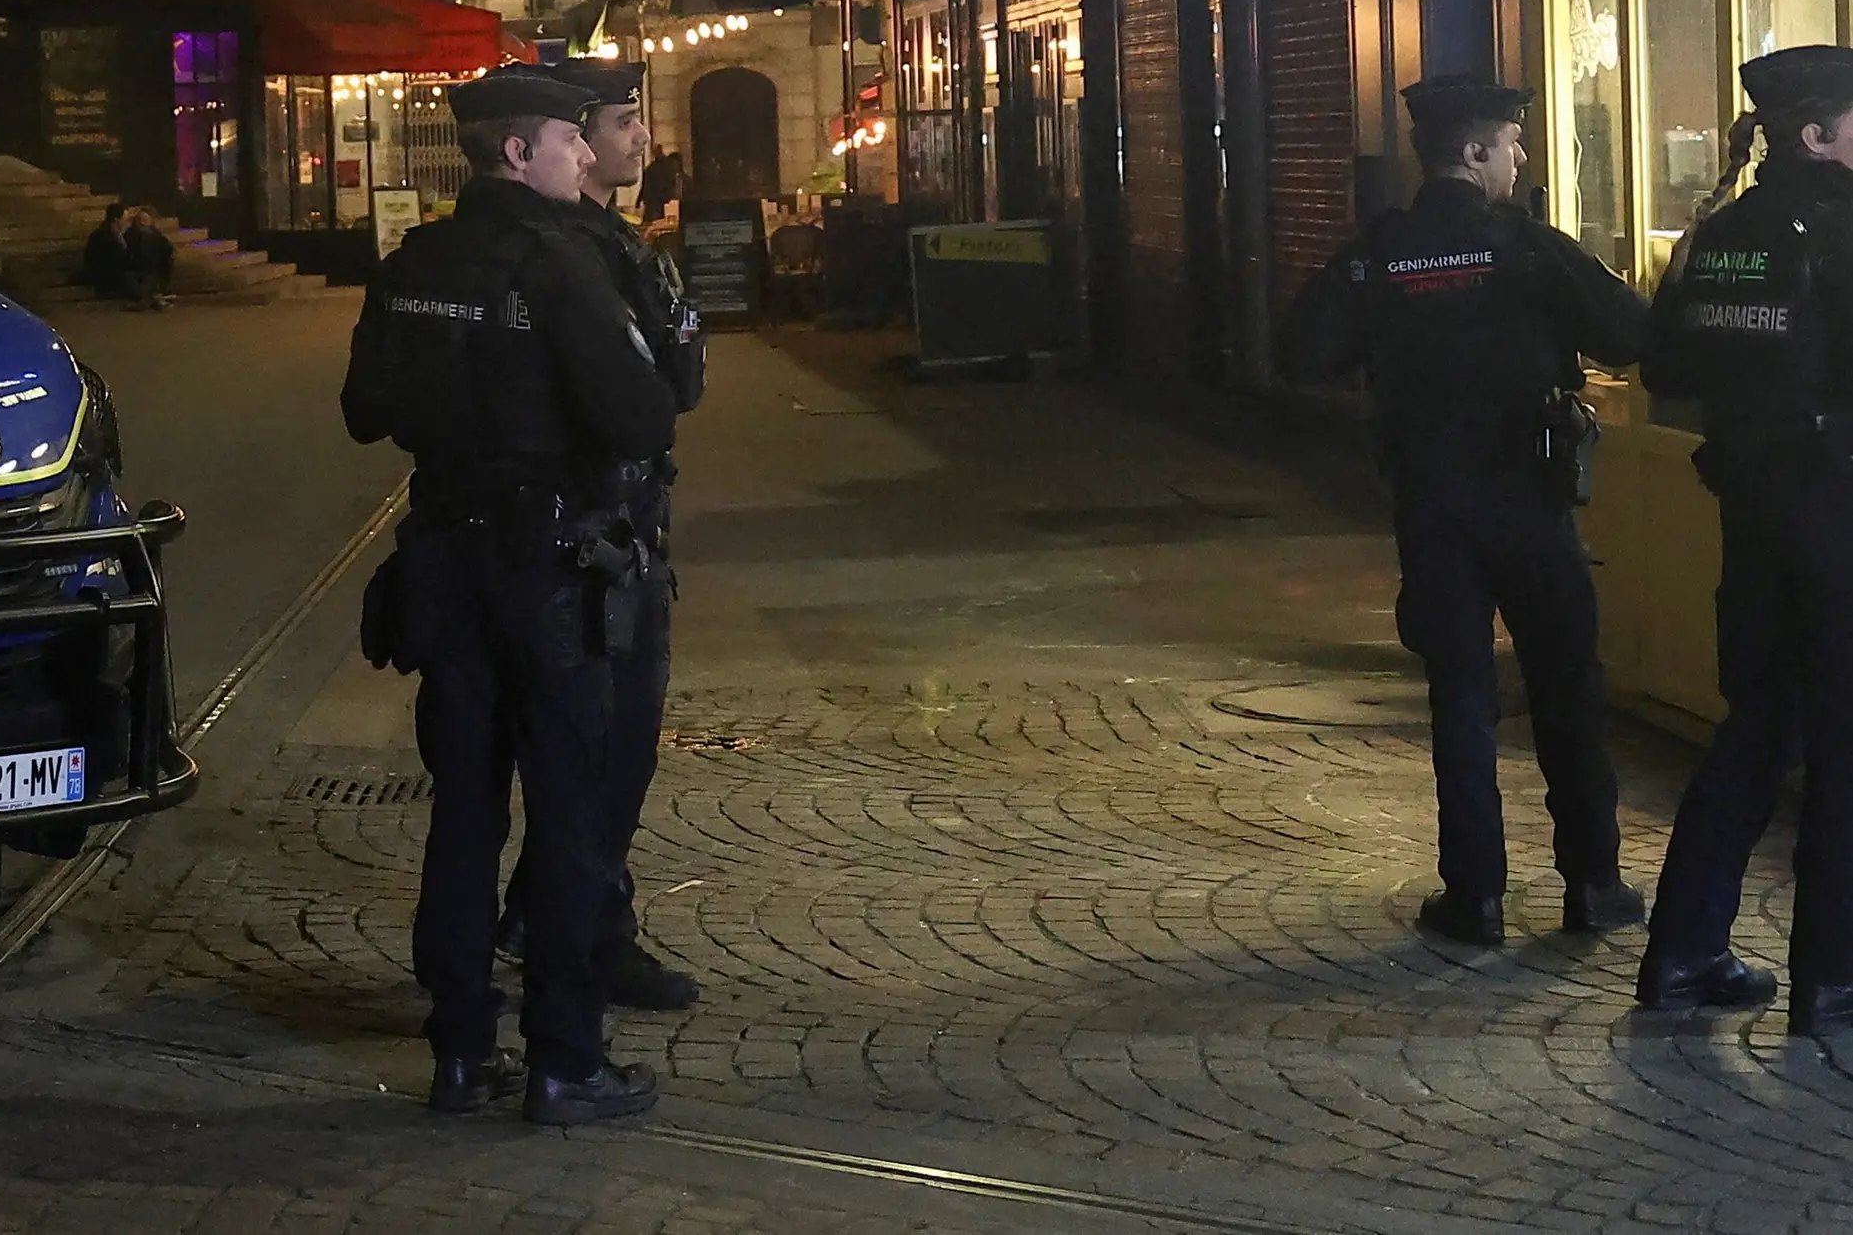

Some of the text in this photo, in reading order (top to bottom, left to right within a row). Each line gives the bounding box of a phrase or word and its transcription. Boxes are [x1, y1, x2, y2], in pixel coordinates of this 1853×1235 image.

[1387, 250, 1494, 273] GENDARMERIE
[390, 297, 485, 322] GENDARMERIE
[68, 777, 81, 796] 78
